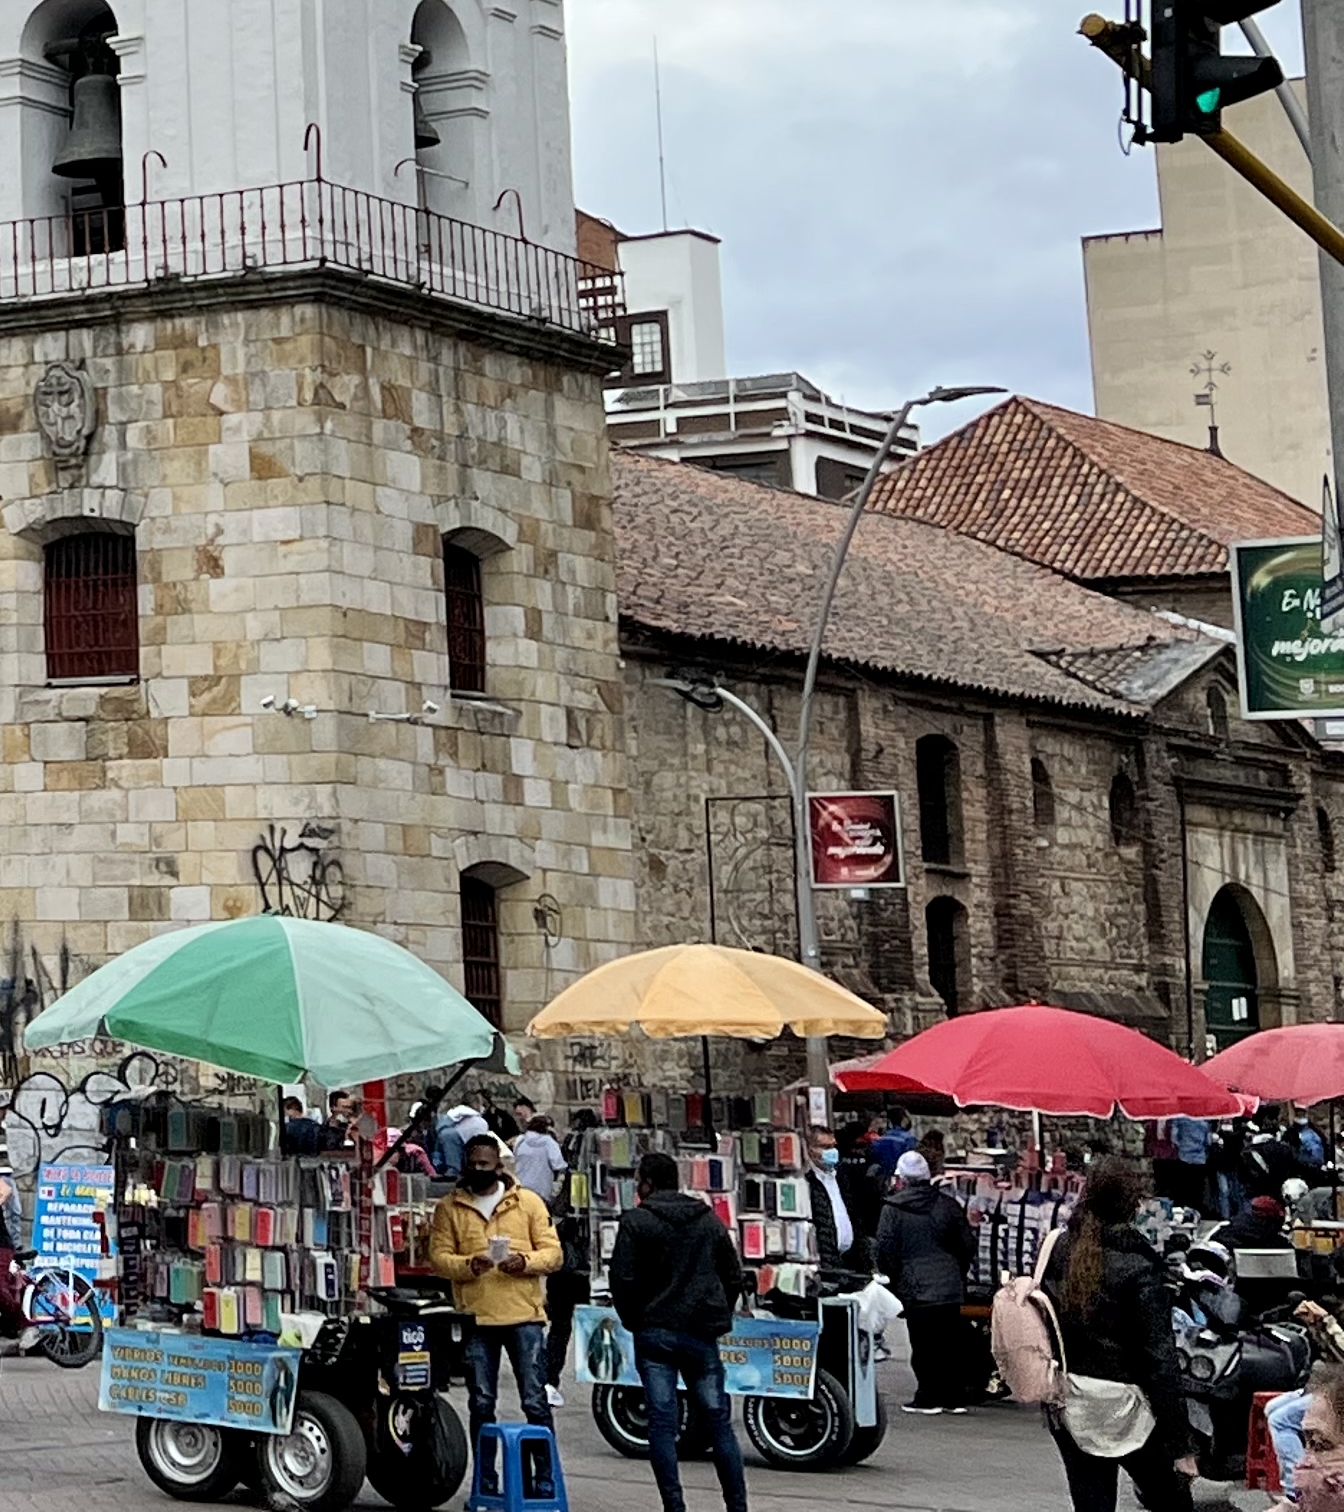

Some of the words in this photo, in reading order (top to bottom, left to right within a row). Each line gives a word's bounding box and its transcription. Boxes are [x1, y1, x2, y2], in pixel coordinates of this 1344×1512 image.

[774, 1337, 812, 1352] 3000
[229, 1359, 263, 1377] 3000
[229, 1378, 263, 1396] 5000
